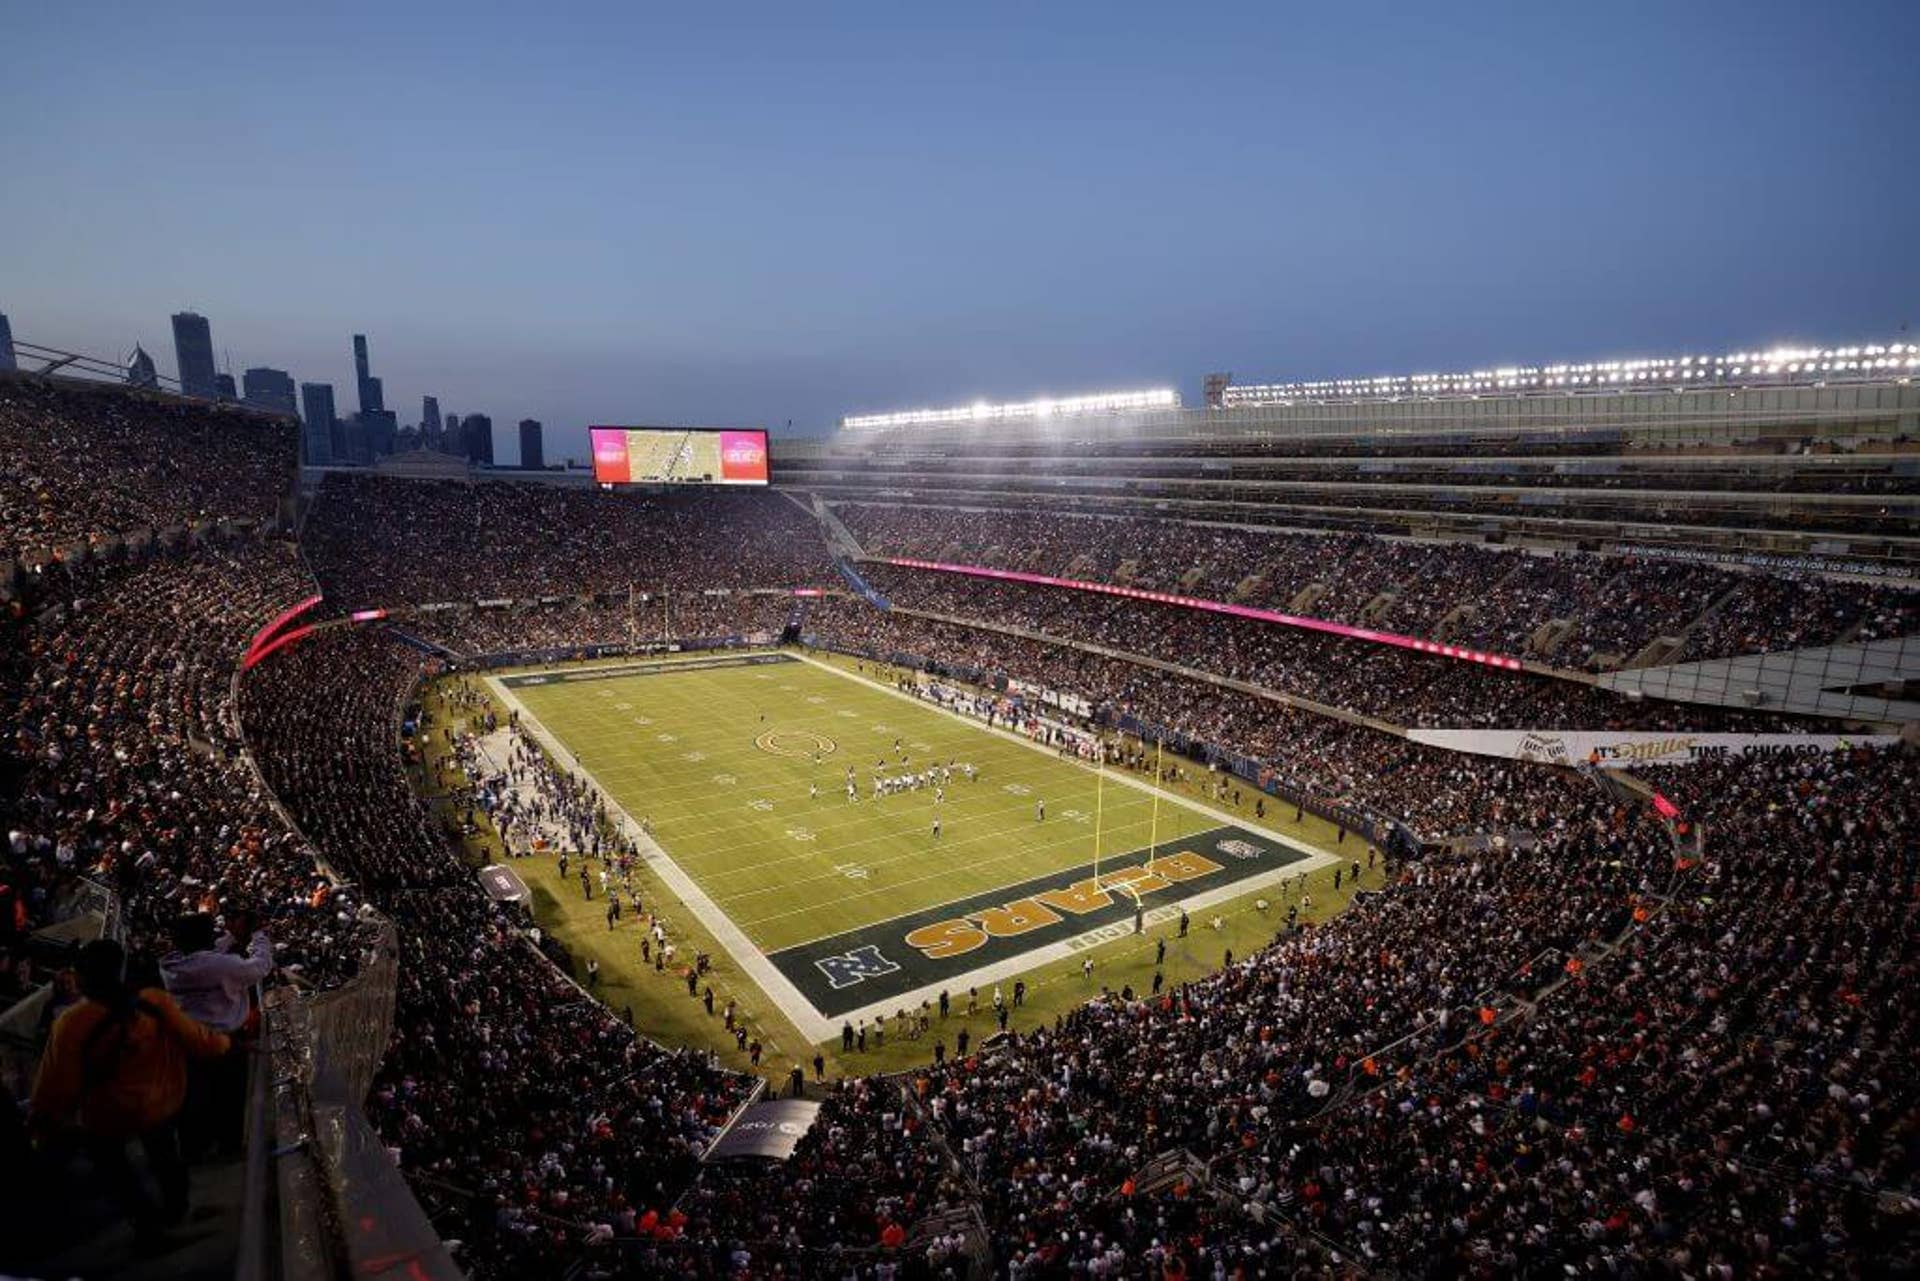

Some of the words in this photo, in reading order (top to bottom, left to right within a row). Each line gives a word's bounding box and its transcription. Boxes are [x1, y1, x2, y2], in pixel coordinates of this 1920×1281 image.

[1688, 745, 1729, 759] TIME
[1743, 744, 1820, 759] CHICAGO
[905, 851, 1225, 960] BEARS
